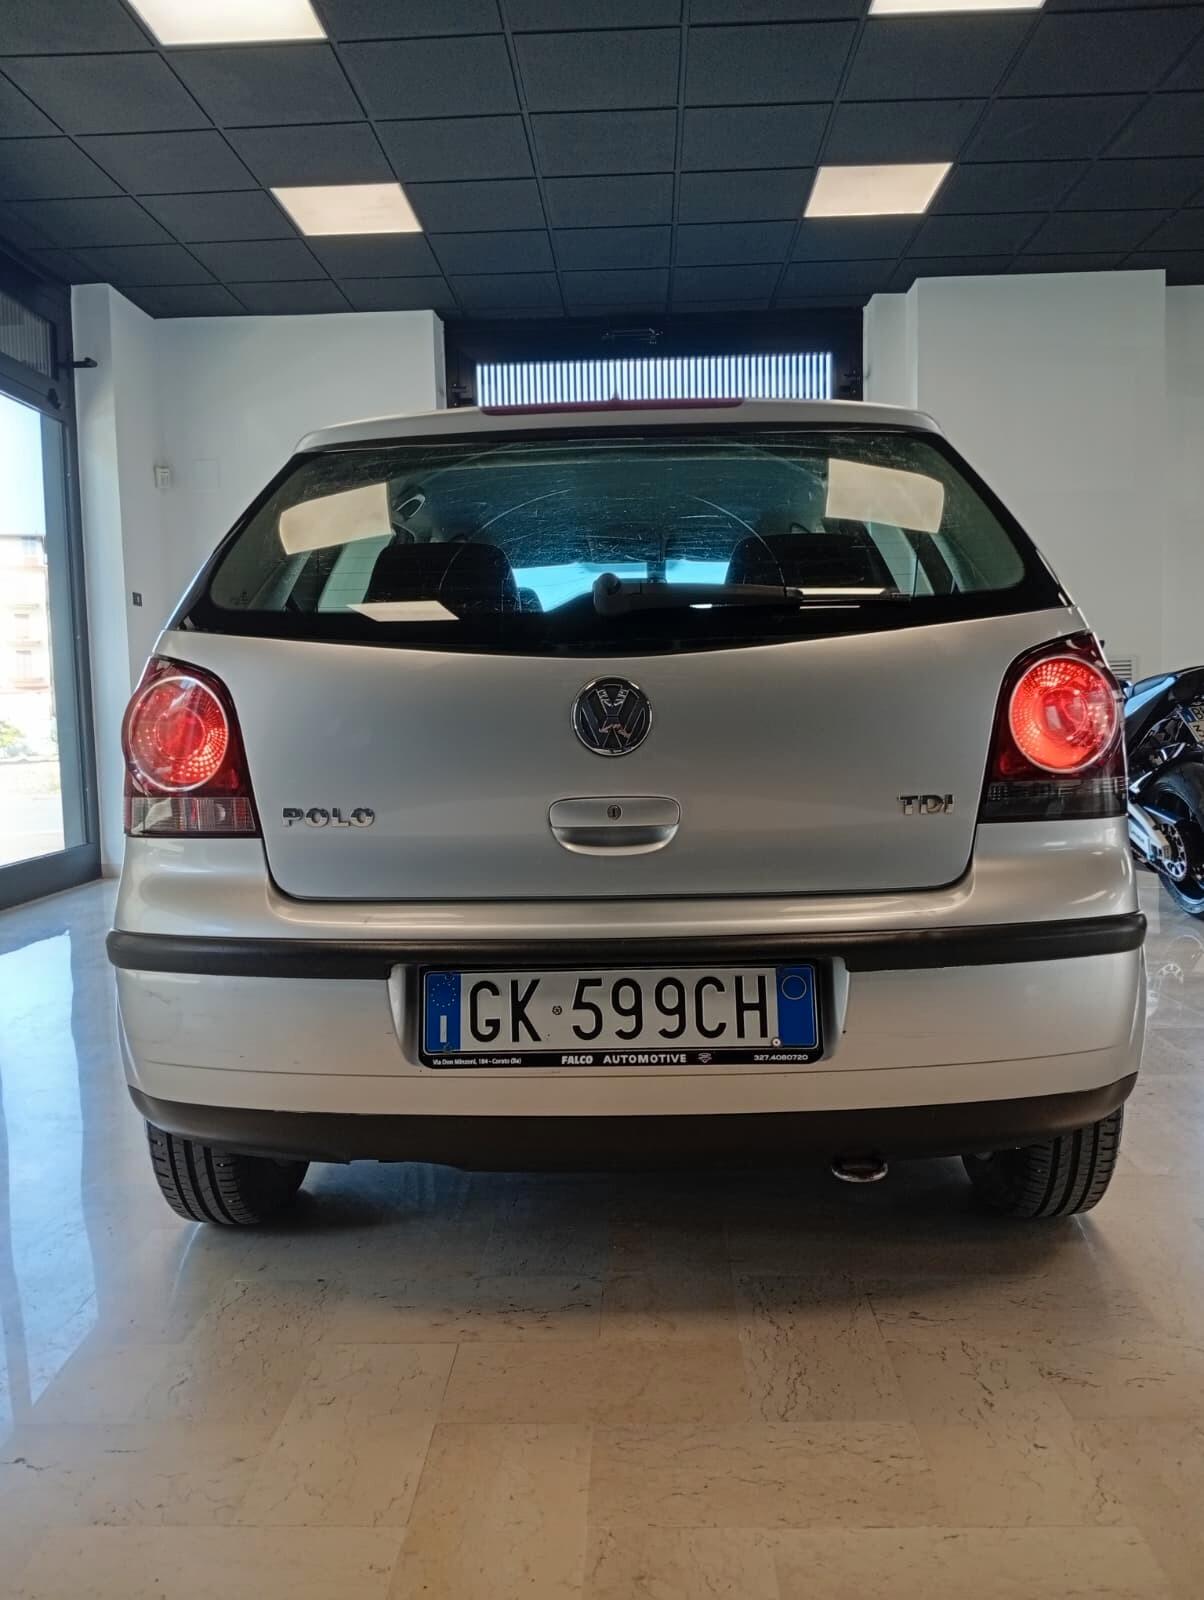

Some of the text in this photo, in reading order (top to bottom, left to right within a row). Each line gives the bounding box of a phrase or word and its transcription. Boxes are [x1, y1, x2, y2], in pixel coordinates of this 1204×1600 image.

[896, 794, 954, 816] TDI
[282, 807, 376, 829] POLO
[469, 975, 769, 1043] GK 599CH
[561, 1053, 687, 1065] FALCO AUTOMOTIVE
